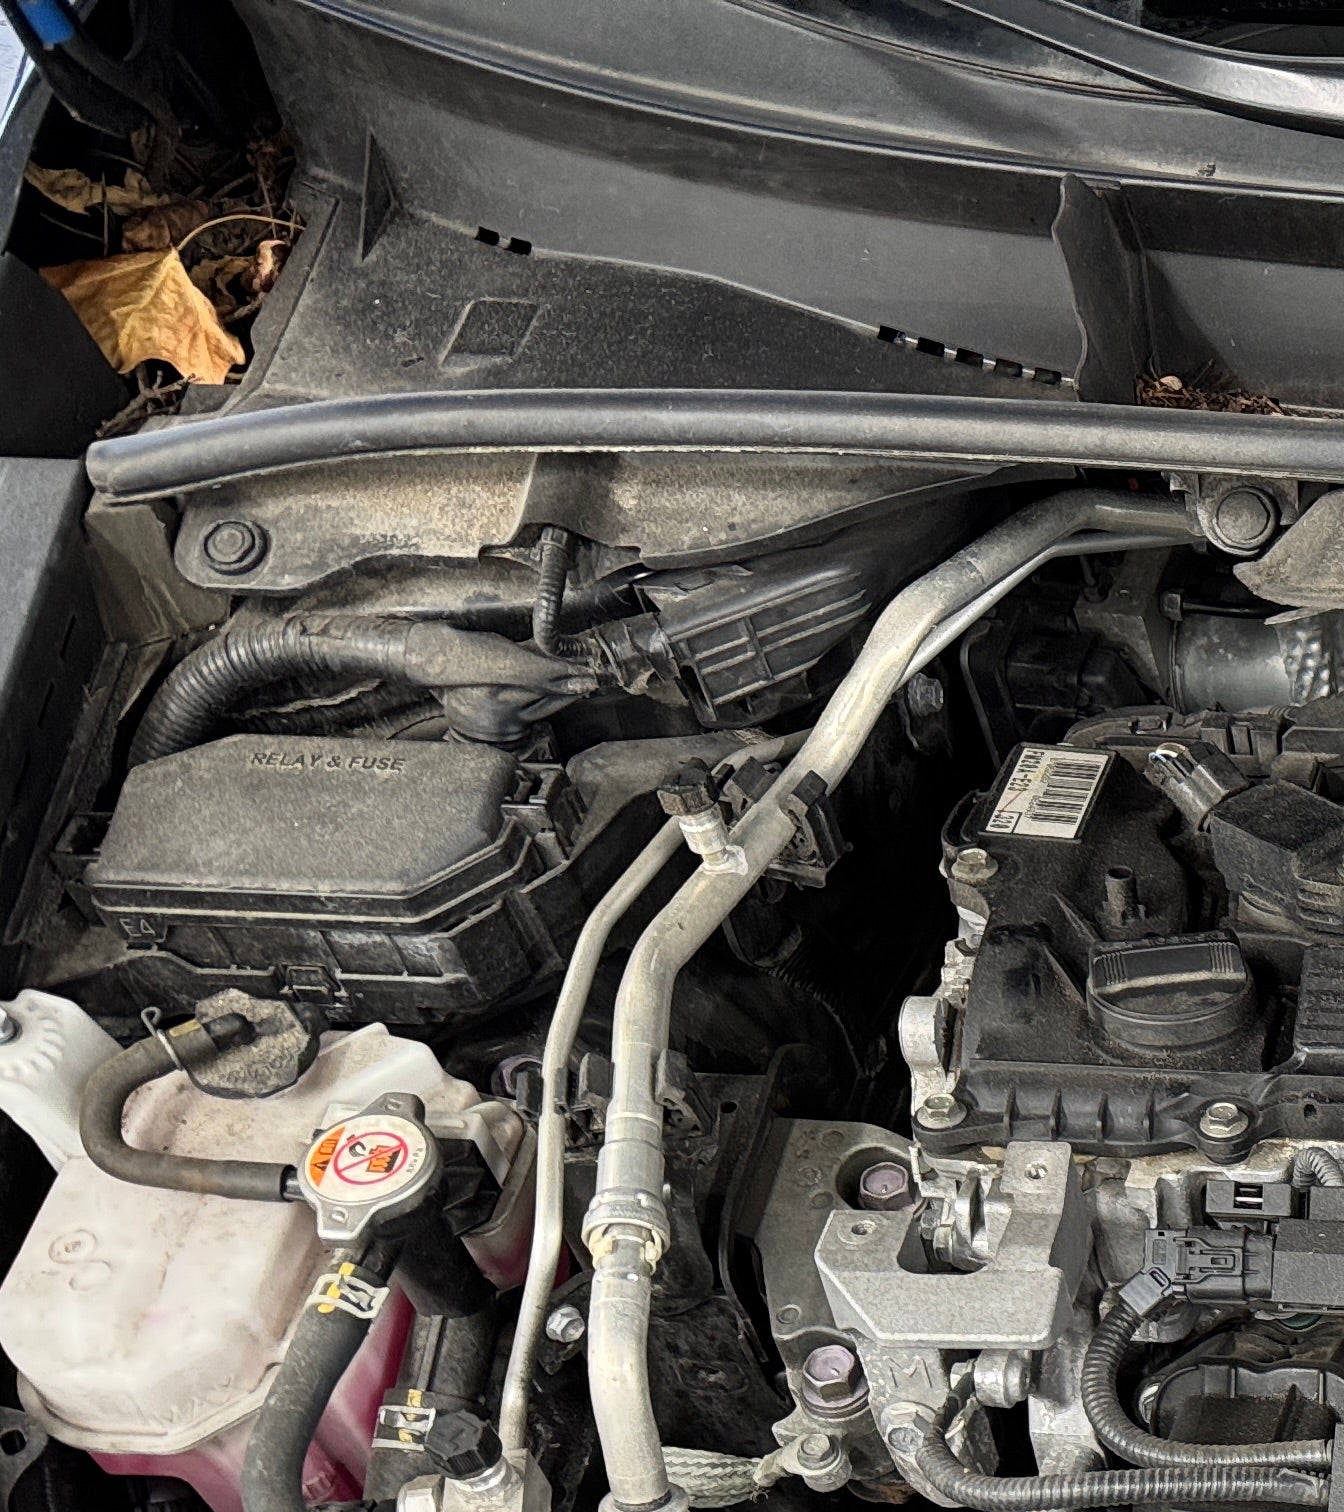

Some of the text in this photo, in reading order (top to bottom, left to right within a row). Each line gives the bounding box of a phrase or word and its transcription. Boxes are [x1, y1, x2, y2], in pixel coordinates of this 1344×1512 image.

[251, 752, 405, 771] RELAY & FUSE
[119, 918, 156, 937] E4
